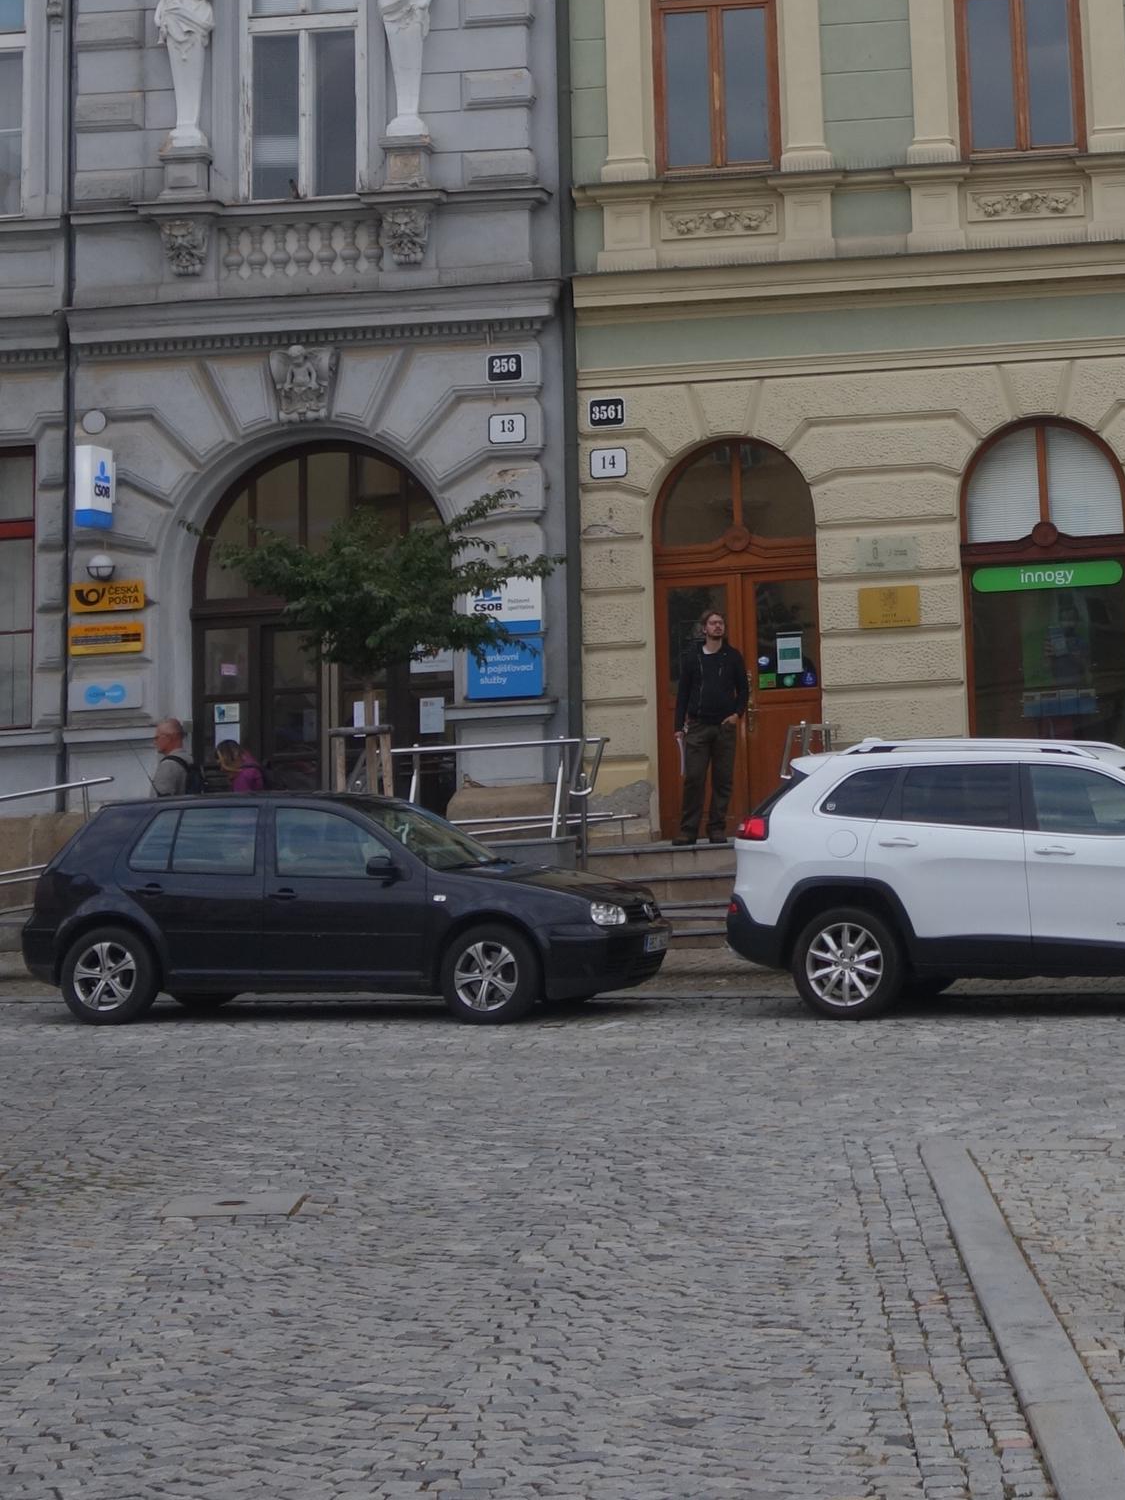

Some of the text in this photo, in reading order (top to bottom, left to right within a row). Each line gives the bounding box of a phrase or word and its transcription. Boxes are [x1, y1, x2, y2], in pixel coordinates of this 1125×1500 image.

[492, 357, 517, 373] 256
[591, 405, 623, 420] 3561
[500, 419, 515, 433] 13
[601, 455, 616, 470] 14
[1020, 569, 1074, 584] innogy
[107, 585, 140, 595] ČESKÁ
[108, 595, 140, 605] POŠTA
[481, 651, 519, 663] ankovní
[480, 676, 508, 685] služby
